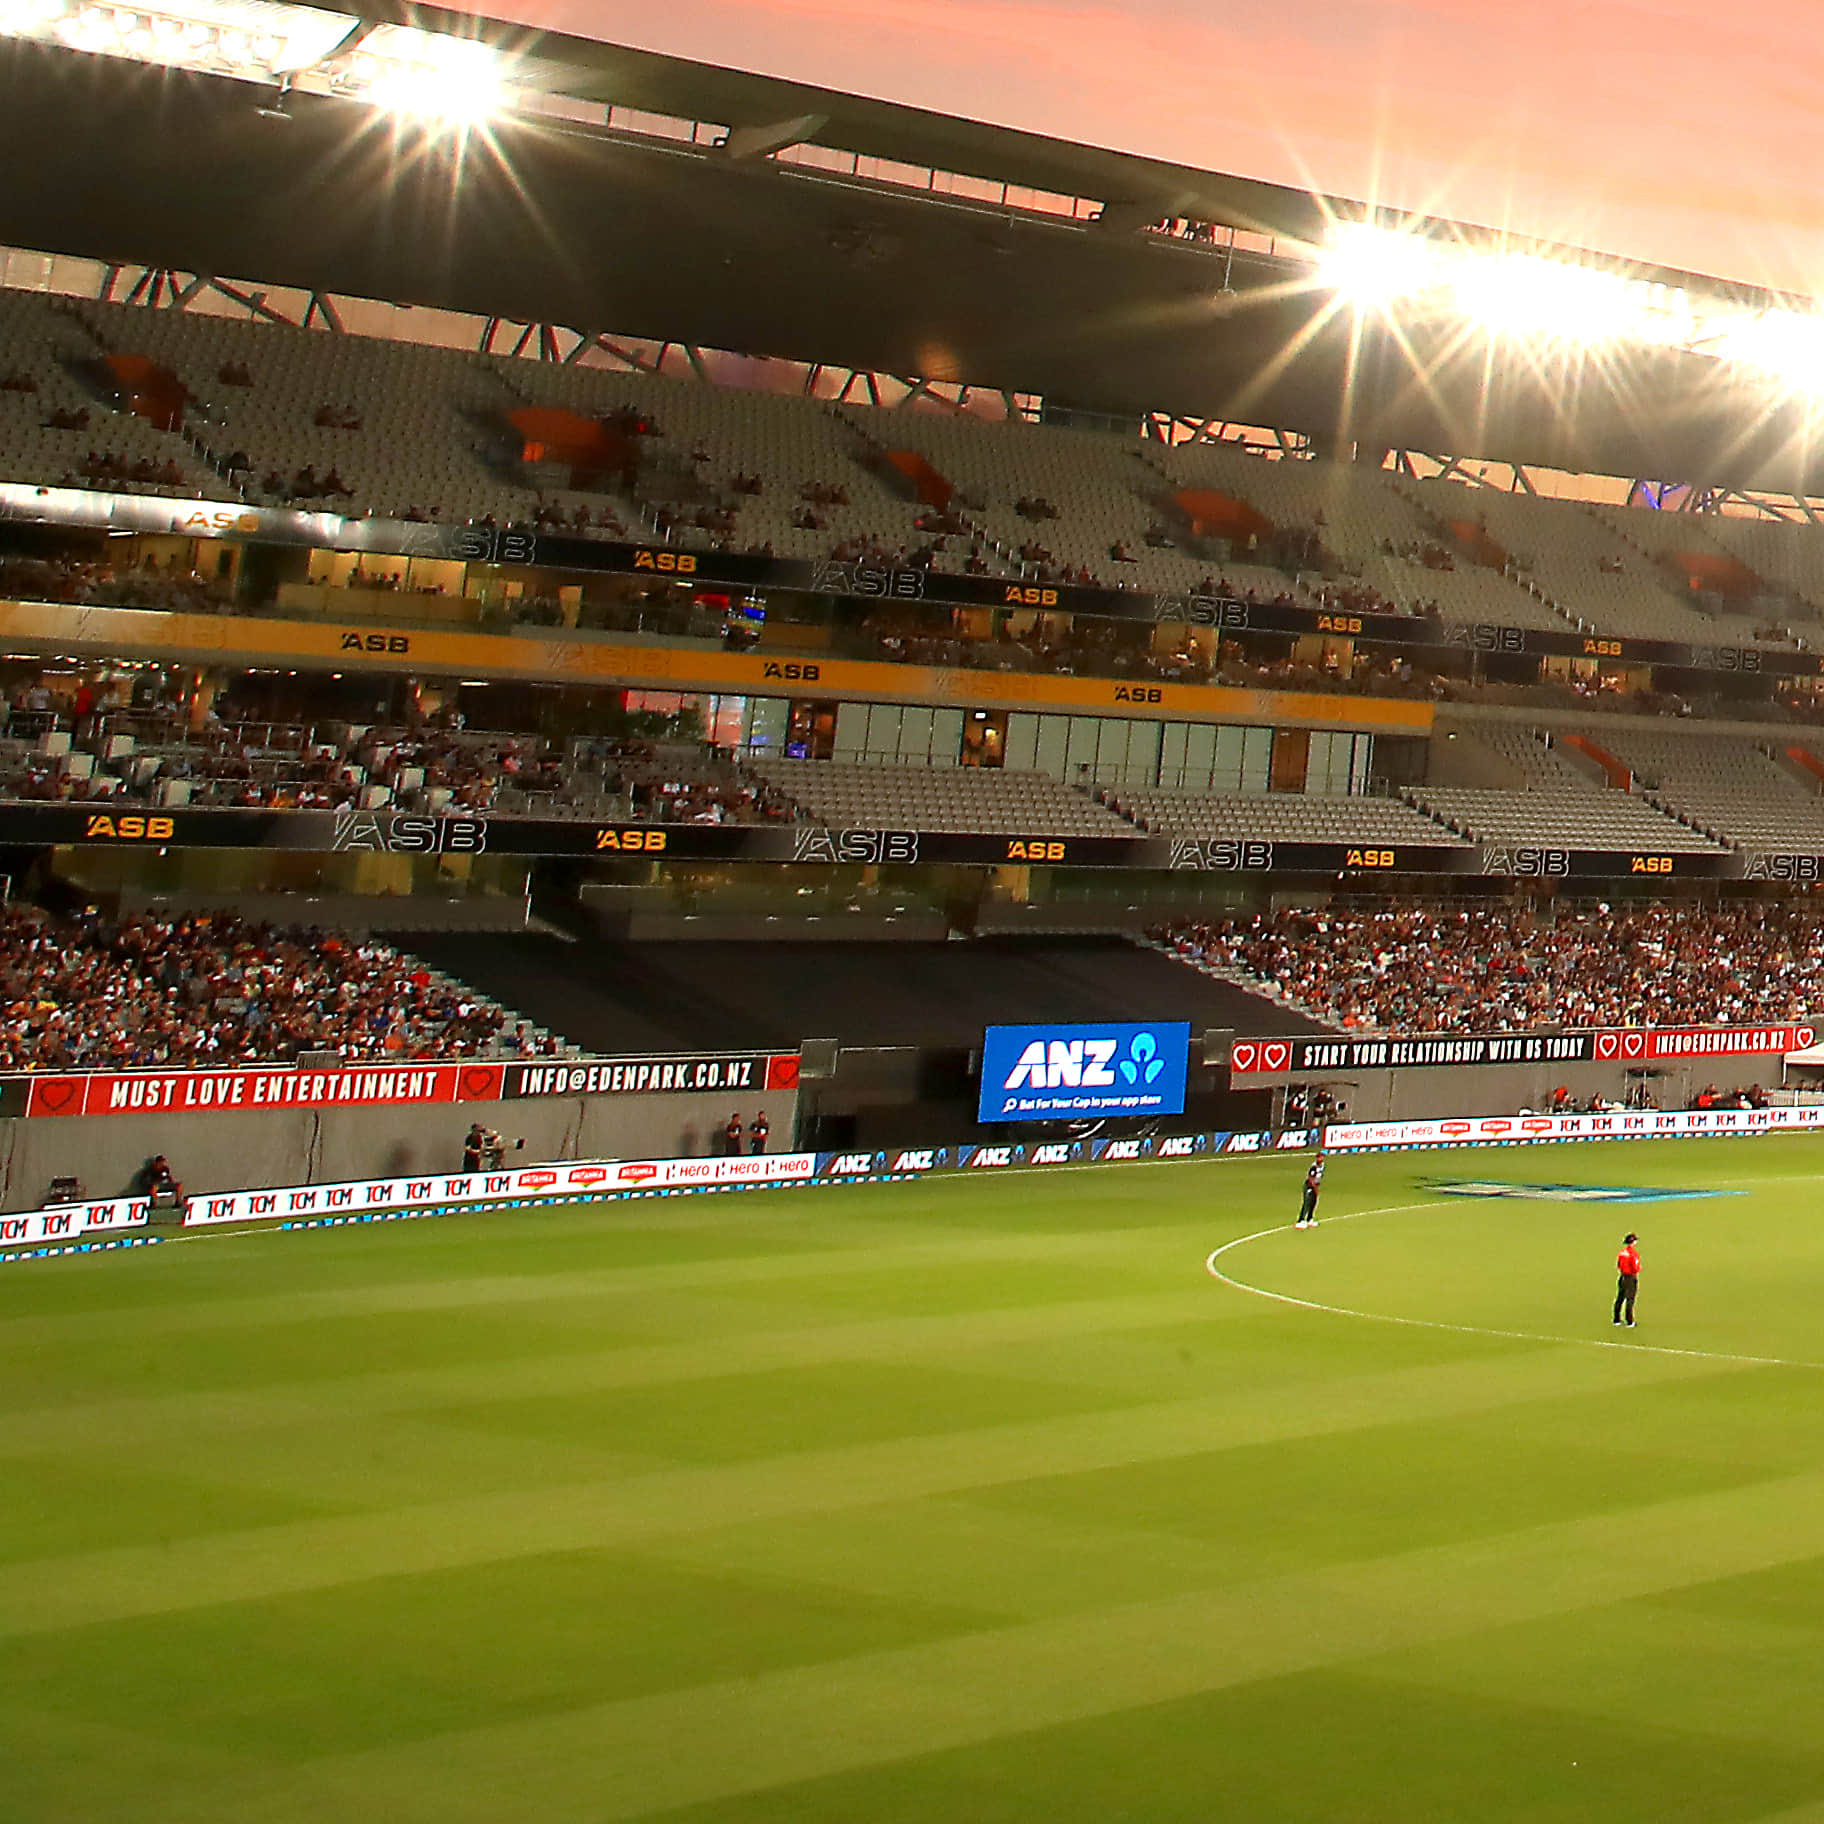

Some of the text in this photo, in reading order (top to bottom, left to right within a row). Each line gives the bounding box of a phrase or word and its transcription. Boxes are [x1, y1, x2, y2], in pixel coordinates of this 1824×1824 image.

[636, 550, 697, 572] ASB
[1006, 586, 1058, 606] ASB
[1318, 616, 1362, 632] ASB
[341, 633, 411, 654] ASB
[1583, 640, 1622, 656] ASB
[764, 662, 820, 681] ASB
[1114, 687, 1162, 703] ASB
[86, 815, 175, 839] ASB
[597, 830, 668, 851] ASB
[1007, 840, 1067, 861] ASB
[1346, 850, 1396, 867] ASB
[1632, 857, 1674, 873] ASB
[1303, 1038, 1585, 1068] START YOUR RELATIONSHIP WITH US TODAY
[1655, 1031, 1786, 1055] INFO@EDENPARK.CO.NZ
[1003, 1039, 1118, 1090] ANZ
[520, 1062, 753, 1095] INFO@EDENPARK.CO.NZ
[110, 1071, 437, 1108] MUST LOVE ENTERTAINMENT
[1591, 1117, 1613, 1131] TCM
[829, 1129, 1309, 1175] ANZ ANZ ANZ ANZ ANZ ANZ ANZ ANZ
[42, 1178, 473, 1236] TCM TCM TCM TCM
